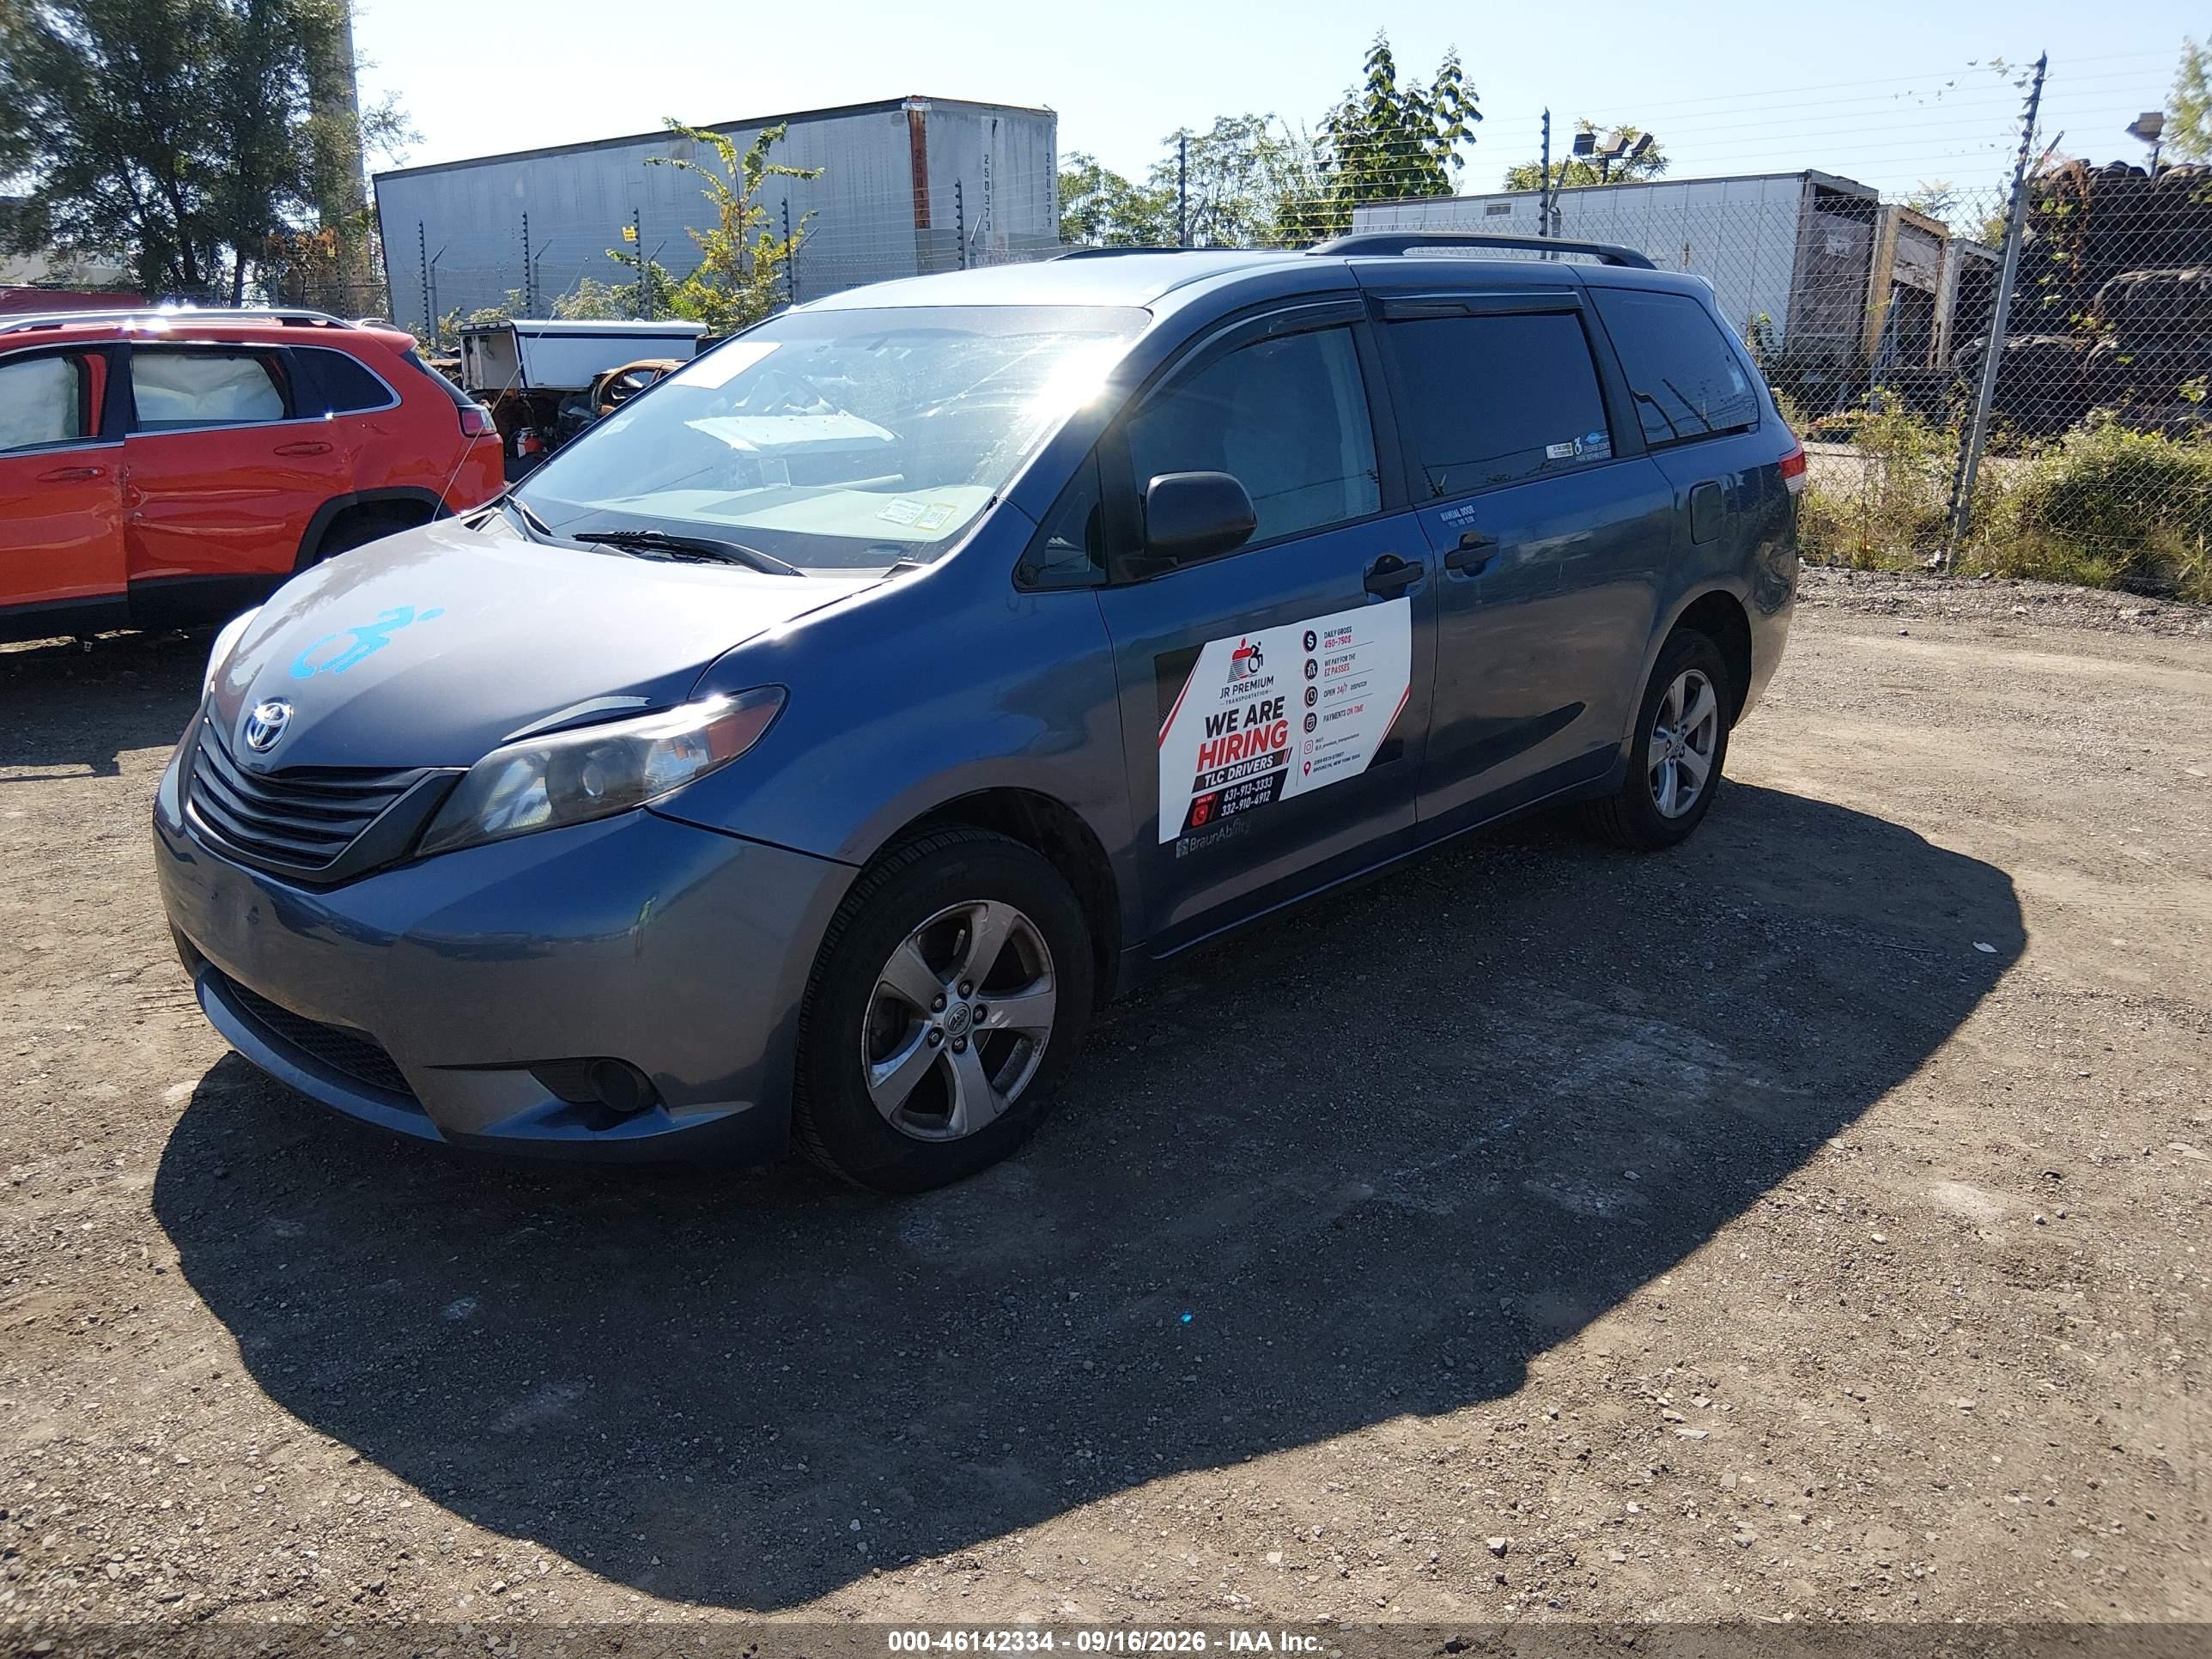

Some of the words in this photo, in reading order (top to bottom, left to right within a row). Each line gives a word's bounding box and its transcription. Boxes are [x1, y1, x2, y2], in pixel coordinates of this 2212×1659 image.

[1439, 508, 1461, 522] MANUAL
[1460, 505, 1475, 517] DOOR
[1324, 629, 1337, 639] DAILY
[1337, 626, 1352, 635] GROSS
[1324, 635, 1352, 649] 450-750$
[1324, 659, 1331, 667] WE
[1331, 656, 1340, 665] PAY
[1340, 654, 1348, 664] FOR
[1324, 667, 1331, 677] EZ
[1331, 663, 1350, 675] PASSES
[1219, 686, 1231, 699] JR
[1232, 676, 1274, 696] PREMIUM
[1323, 688, 1336, 698] OPEN
[1336, 682, 1348, 695] 24/7
[1225, 690, 1268, 706] TRANSPORTATION
[1205, 708, 1239, 739] WE
[1243, 696, 1285, 728] ARE
[1323, 709, 1346, 723] PAYMENTS
[1346, 706, 1354, 715] ON
[1353, 703, 1364, 714] TIME
[1197, 720, 1289, 773] HIRING
[1205, 773, 1225, 787] TLC
[1227, 756, 1273, 781] DRIVERS
[1224, 776, 1273, 802] 631-913-3333
[1221, 790, 1271, 817] 332-910-6912
[1190, 817, 1251, 853] BraunAbility
